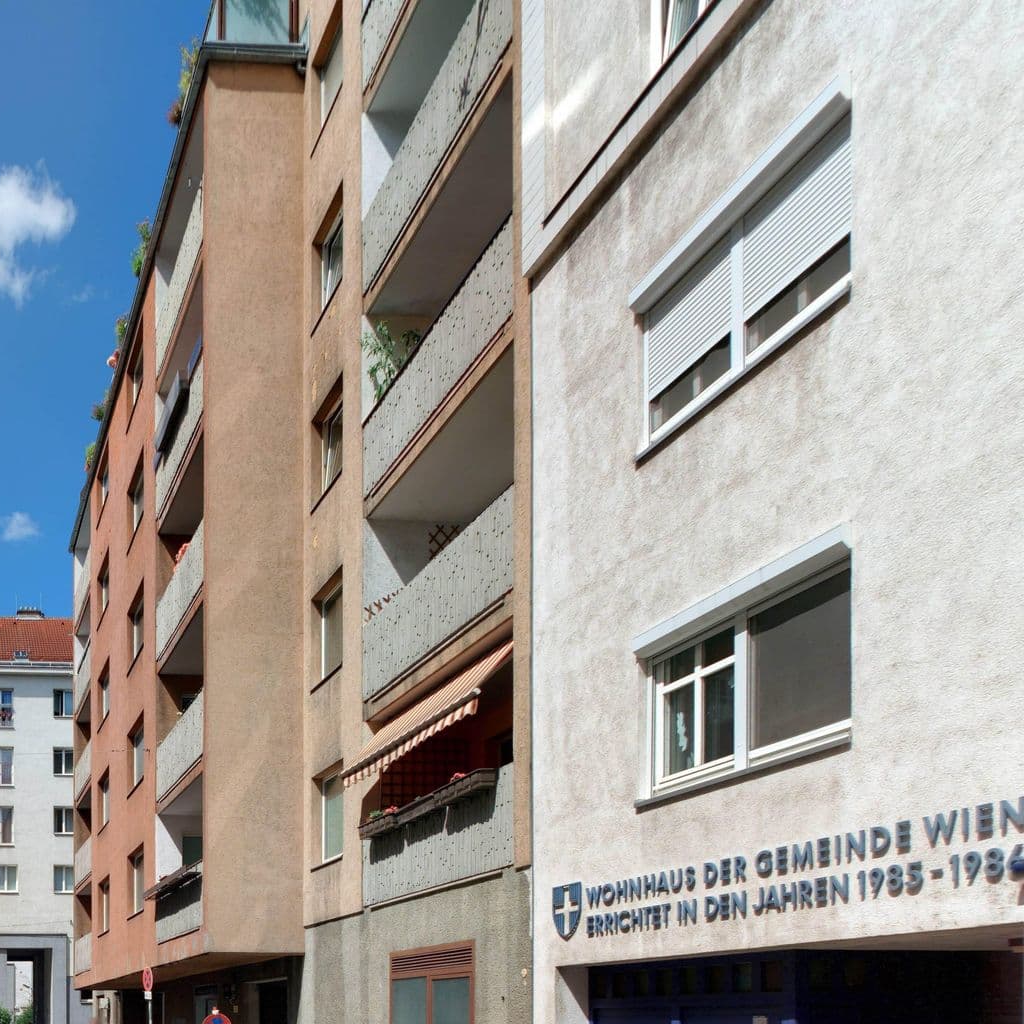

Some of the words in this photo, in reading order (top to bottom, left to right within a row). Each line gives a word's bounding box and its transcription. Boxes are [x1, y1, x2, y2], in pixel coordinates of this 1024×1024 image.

[586, 866, 696, 909] WOHNHAUS
[704, 855, 747, 889] DER
[755, 820, 912, 878] GEMEINDE
[922, 795, 1024, 849] WIEN
[586, 902, 672, 938] ERRICHTET
[677, 898, 698, 927] IN
[704, 889, 748, 923] DEN
[752, 873, 849, 916] JAHREN
